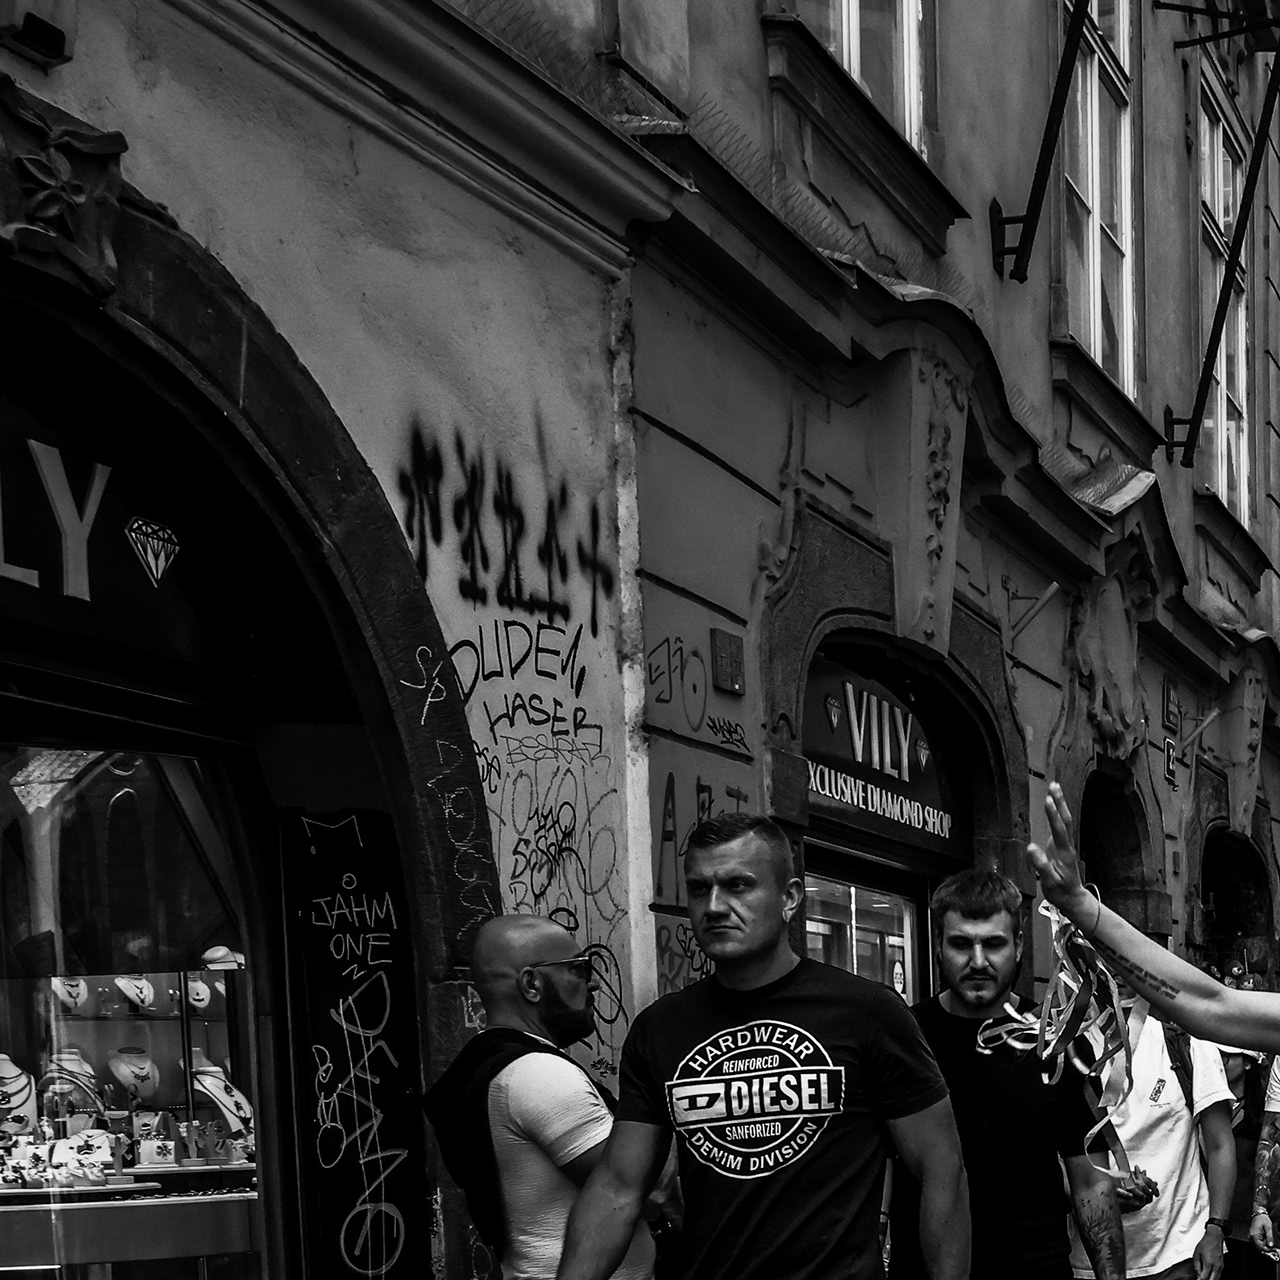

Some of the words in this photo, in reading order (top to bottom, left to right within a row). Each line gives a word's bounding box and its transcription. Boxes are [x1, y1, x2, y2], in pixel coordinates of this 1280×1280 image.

[843, 682, 913, 783] VILY
[808, 760, 867, 810] XCLUSIVE
[867, 783, 924, 830] DIAMOND
[924, 806, 952, 839] SHOP
[688, 1026, 815, 1071] HARDWEAR
[722, 1054, 780, 1074] REINFORCED
[730, 1073, 836, 1117] DIESEL
[690, 1131, 743, 1171] DENIM
[749, 1121, 818, 1172] DIVISION
[725, 1121, 781, 1141] SANFORIZED
